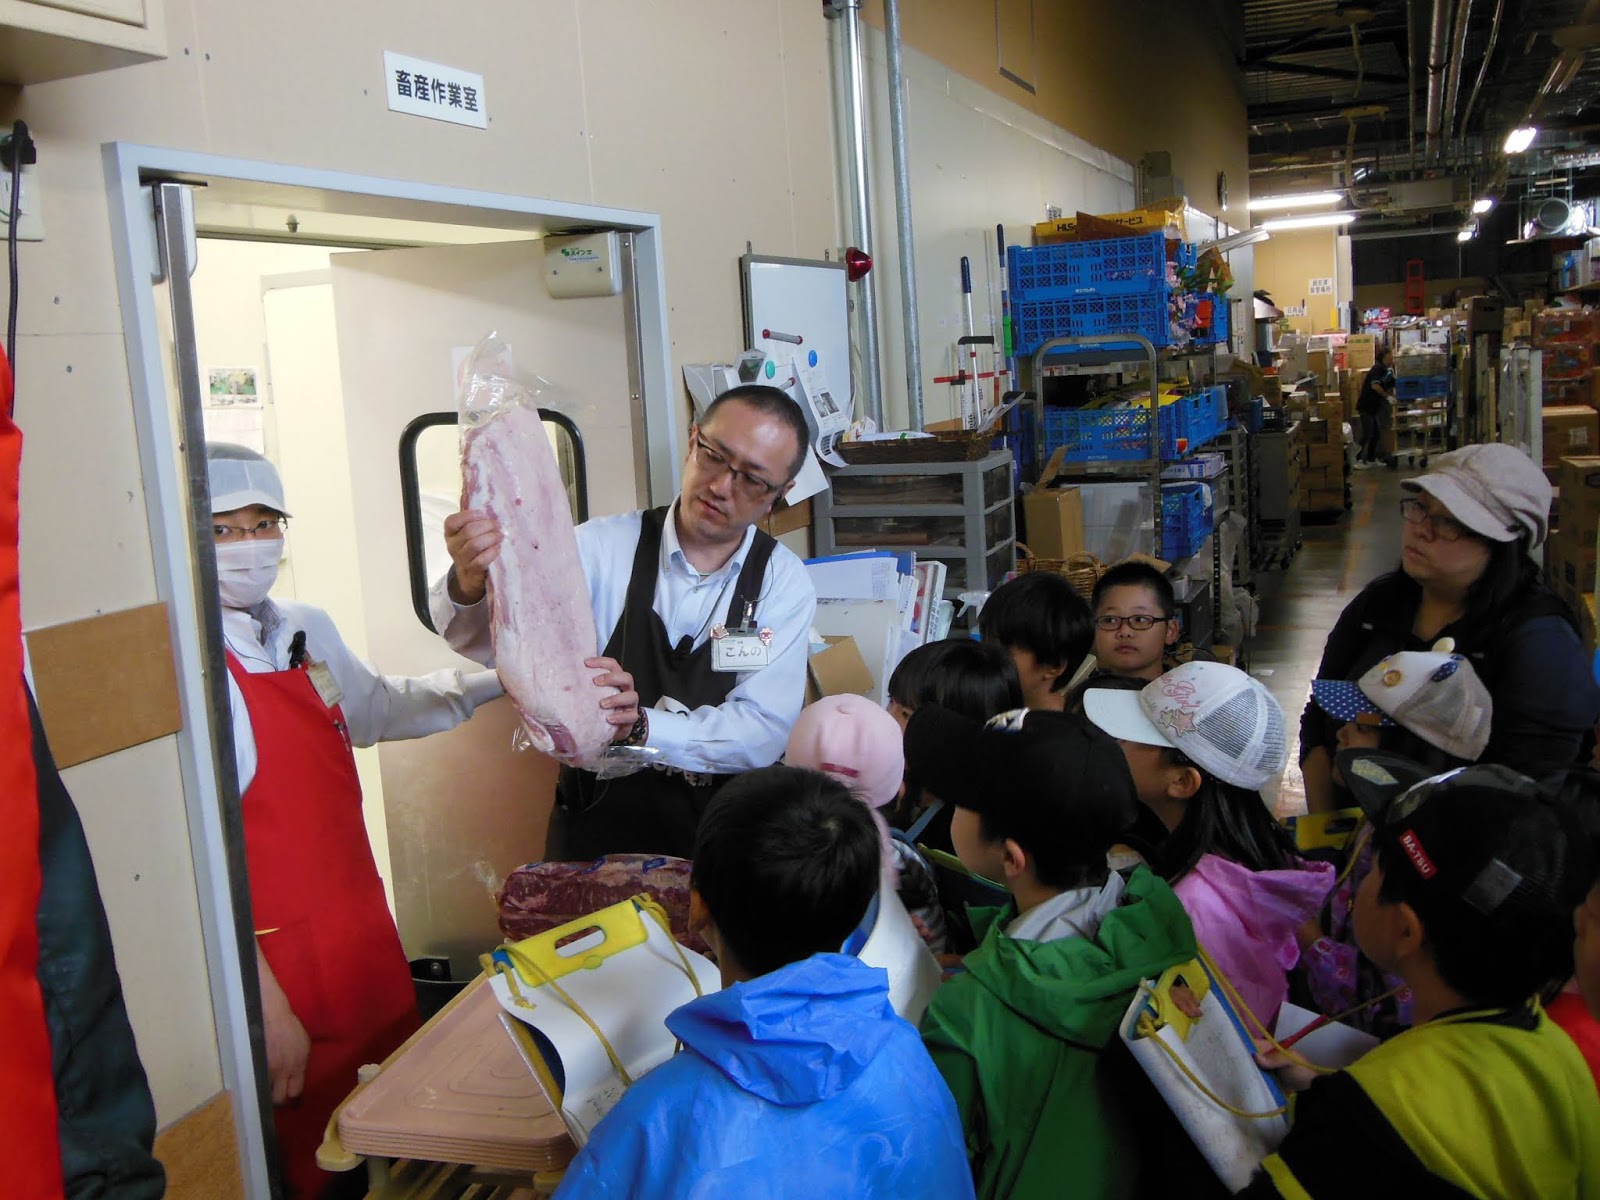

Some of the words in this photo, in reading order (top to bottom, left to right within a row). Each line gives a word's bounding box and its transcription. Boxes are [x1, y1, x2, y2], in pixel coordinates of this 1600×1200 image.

[395, 69, 479, 113] 畜産作業室
[725, 645, 762, 658] こんの
